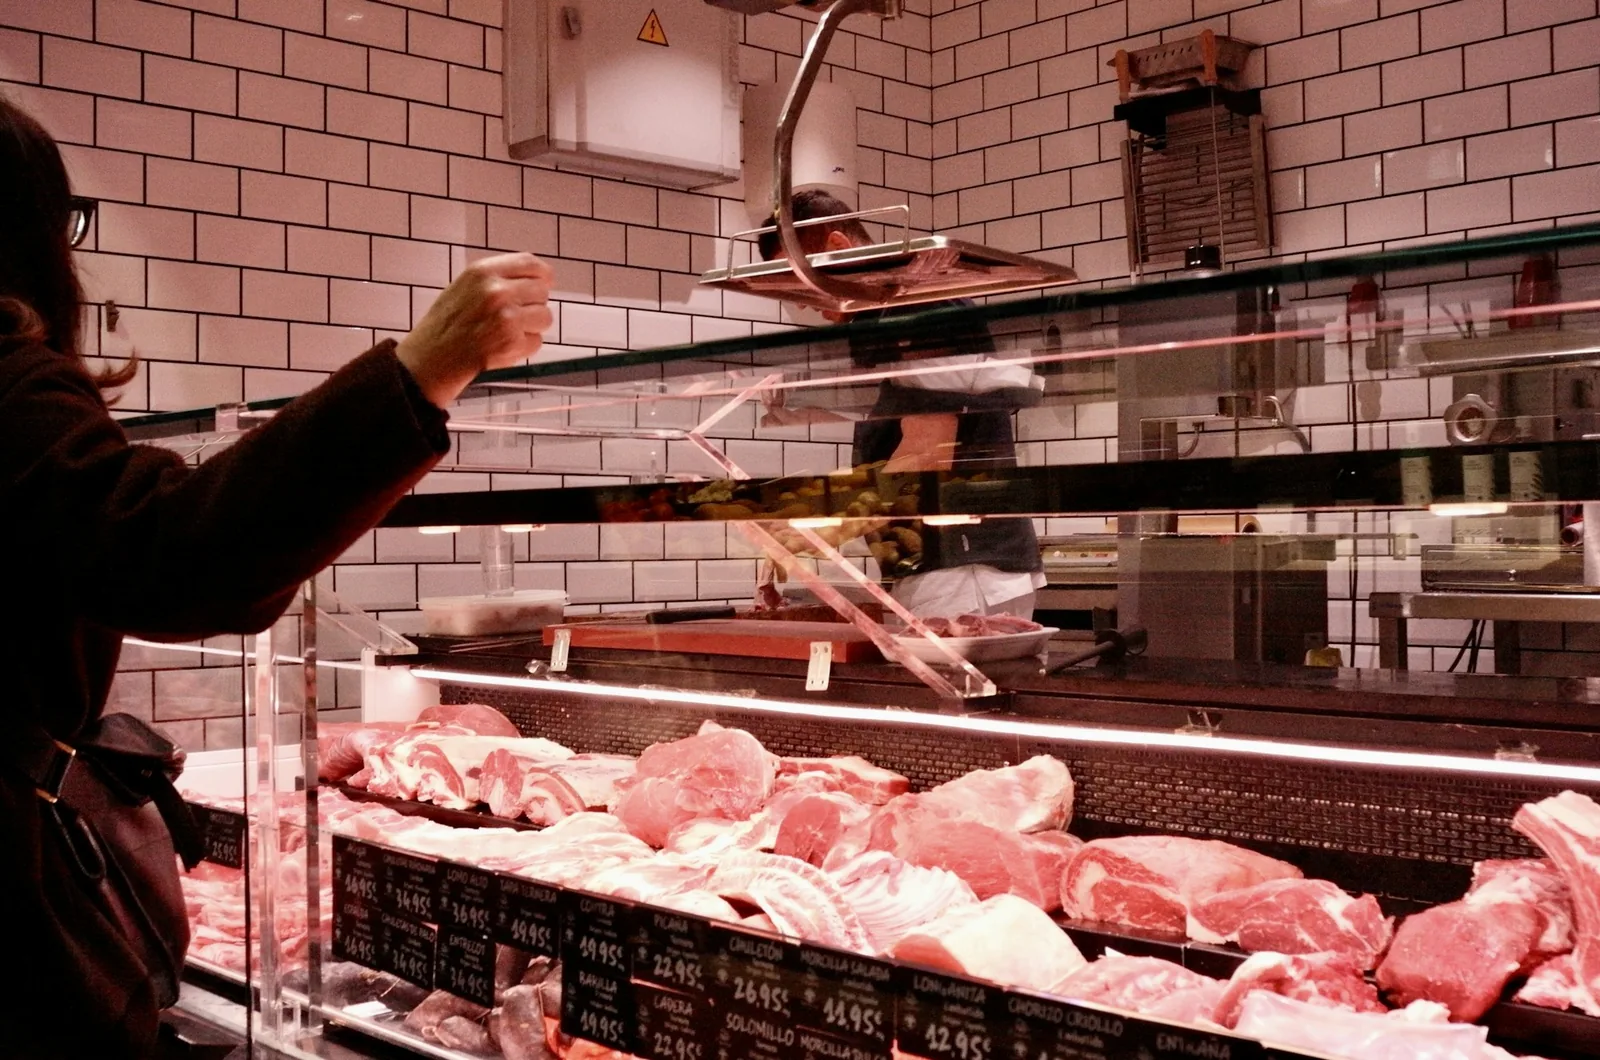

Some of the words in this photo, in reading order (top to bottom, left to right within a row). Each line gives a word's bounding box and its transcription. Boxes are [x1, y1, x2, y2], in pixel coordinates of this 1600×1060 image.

[446, 868, 469, 885] LOMO
[729, 936, 784, 961] CHULETÓN
[654, 995, 693, 1016] CADERA
[1007, 996, 1063, 1024] CHORIZO
[726, 1012, 795, 1046] SOLOMILLO
[800, 1034, 851, 1060] MORCILLA
